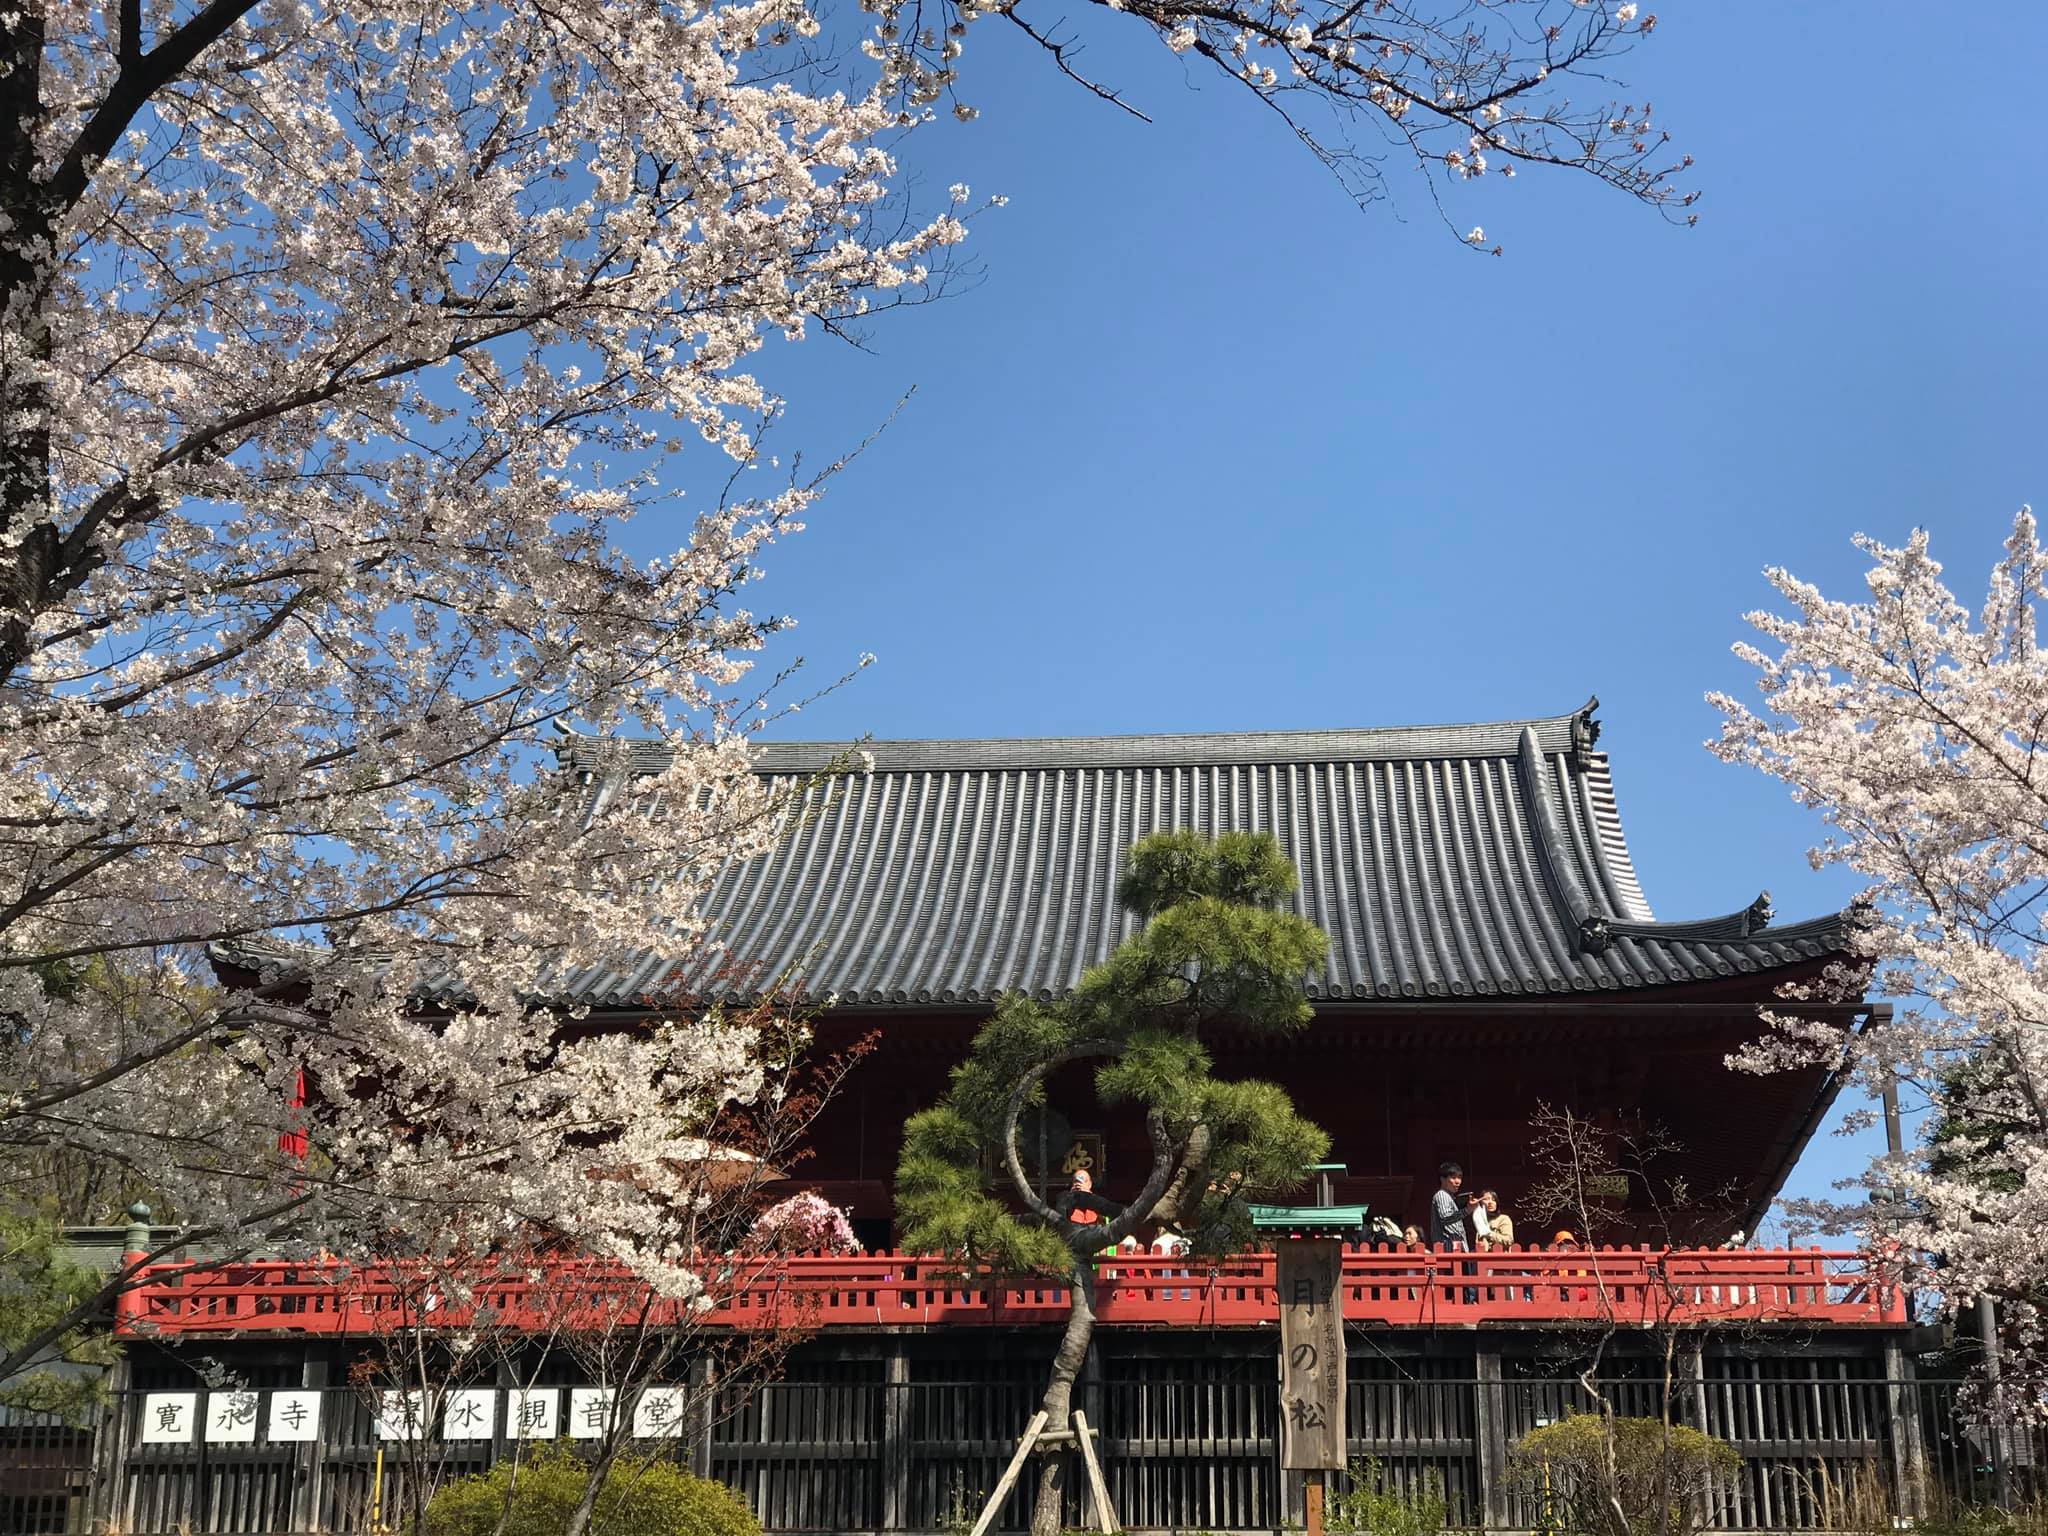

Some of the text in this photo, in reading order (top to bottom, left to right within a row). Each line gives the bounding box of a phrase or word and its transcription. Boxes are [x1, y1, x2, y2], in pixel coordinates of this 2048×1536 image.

[1290, 1278, 1327, 1431] 月の松
[155, 1400, 309, 1432] 寛永寺
[387, 1396, 674, 1430] 清水観音堂
